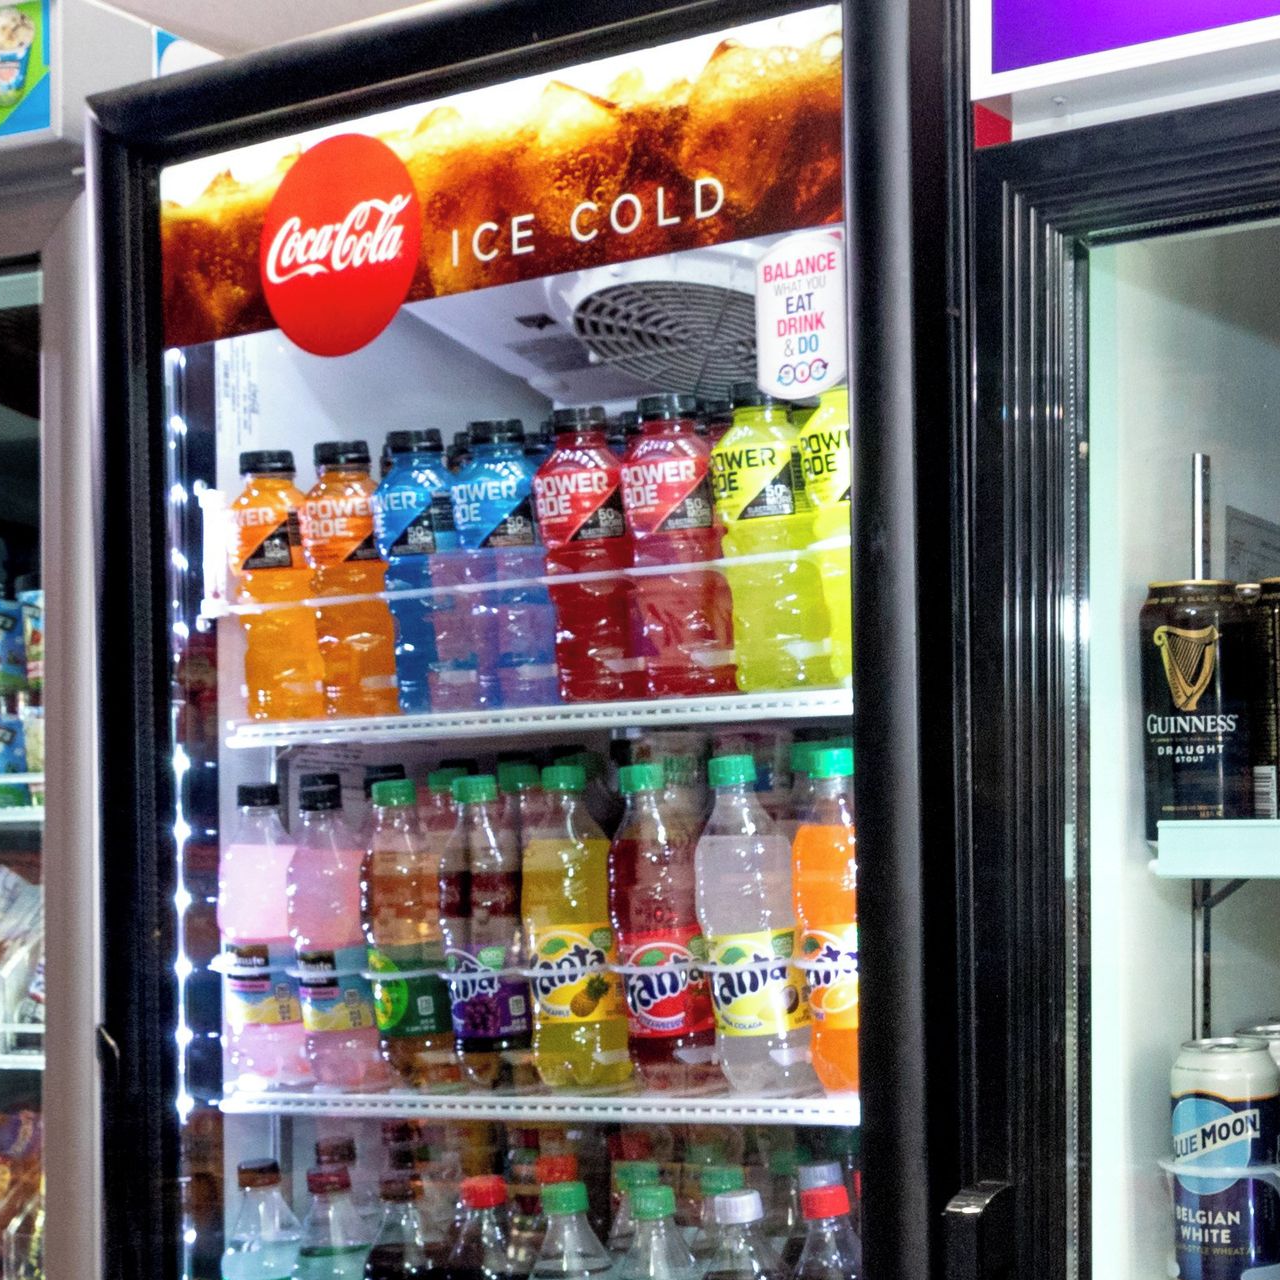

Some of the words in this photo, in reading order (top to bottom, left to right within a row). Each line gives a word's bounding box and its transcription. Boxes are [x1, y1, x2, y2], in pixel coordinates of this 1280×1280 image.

[451, 214, 536, 267] ICE
[570, 177, 726, 241] COLD
[265, 192, 411, 283] Coca-Cola
[763, 252, 836, 283] BALANCE
[774, 280, 802, 296] WHAT
[806, 275, 827, 290] YOU
[785, 292, 815, 315] EAT
[777, 312, 826, 337] DRINK
[783, 338, 795, 358] &
[798, 333, 820, 354] DO
[800, 430, 844, 454] POW
[534, 472, 609, 496] POWER
[621, 460, 696, 484] POWER
[1146, 713, 1237, 734] GUINNESS
[1157, 744, 1225, 757] DRAUGHT
[1175, 755, 1205, 763] STOUT
[1200, 1113, 1259, 1150] MOON
[1176, 1205, 1241, 1226] BELGIAN
[1180, 1226, 1232, 1244] WHITE
